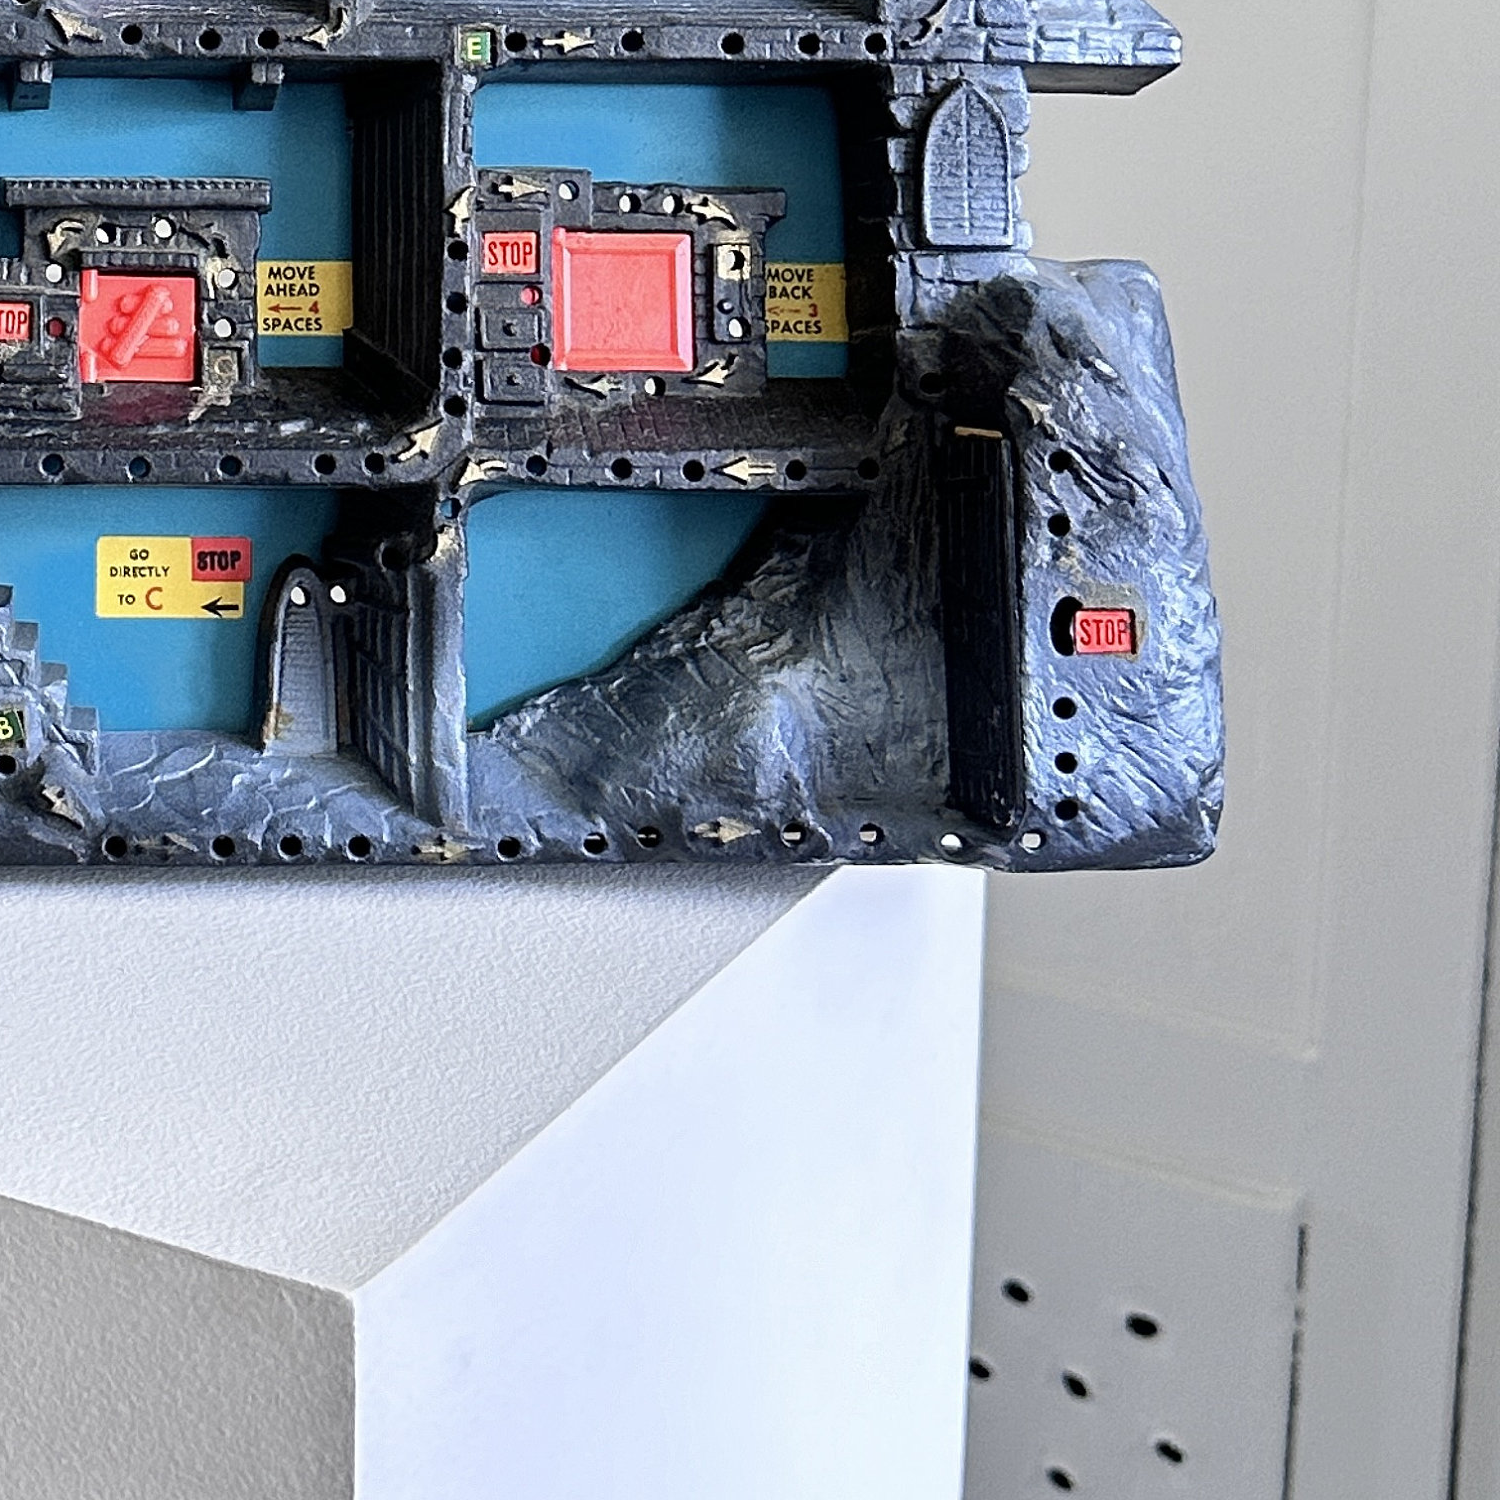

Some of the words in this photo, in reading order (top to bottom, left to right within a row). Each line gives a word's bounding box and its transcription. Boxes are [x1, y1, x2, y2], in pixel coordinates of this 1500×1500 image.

[467, 36, 483, 60] E
[489, 241, 532, 267] STOP
[268, 265, 315, 281] MOVE
[767, 268, 814, 282] MOVE
[264, 283, 320, 297] AHEAD
[768, 285, 813, 300] BACK
[308, 300, 320, 314] 4
[808, 303, 818, 318] 3
[262, 317, 323, 332] SPACES
[129, 548, 149, 560] GO
[196, 550, 242, 571] STOP
[109, 566, 170, 578] DIRECTLY
[117, 594, 136, 605] TO
[145, 586, 163, 610] C
[1079, 619, 1127, 646] STOP
